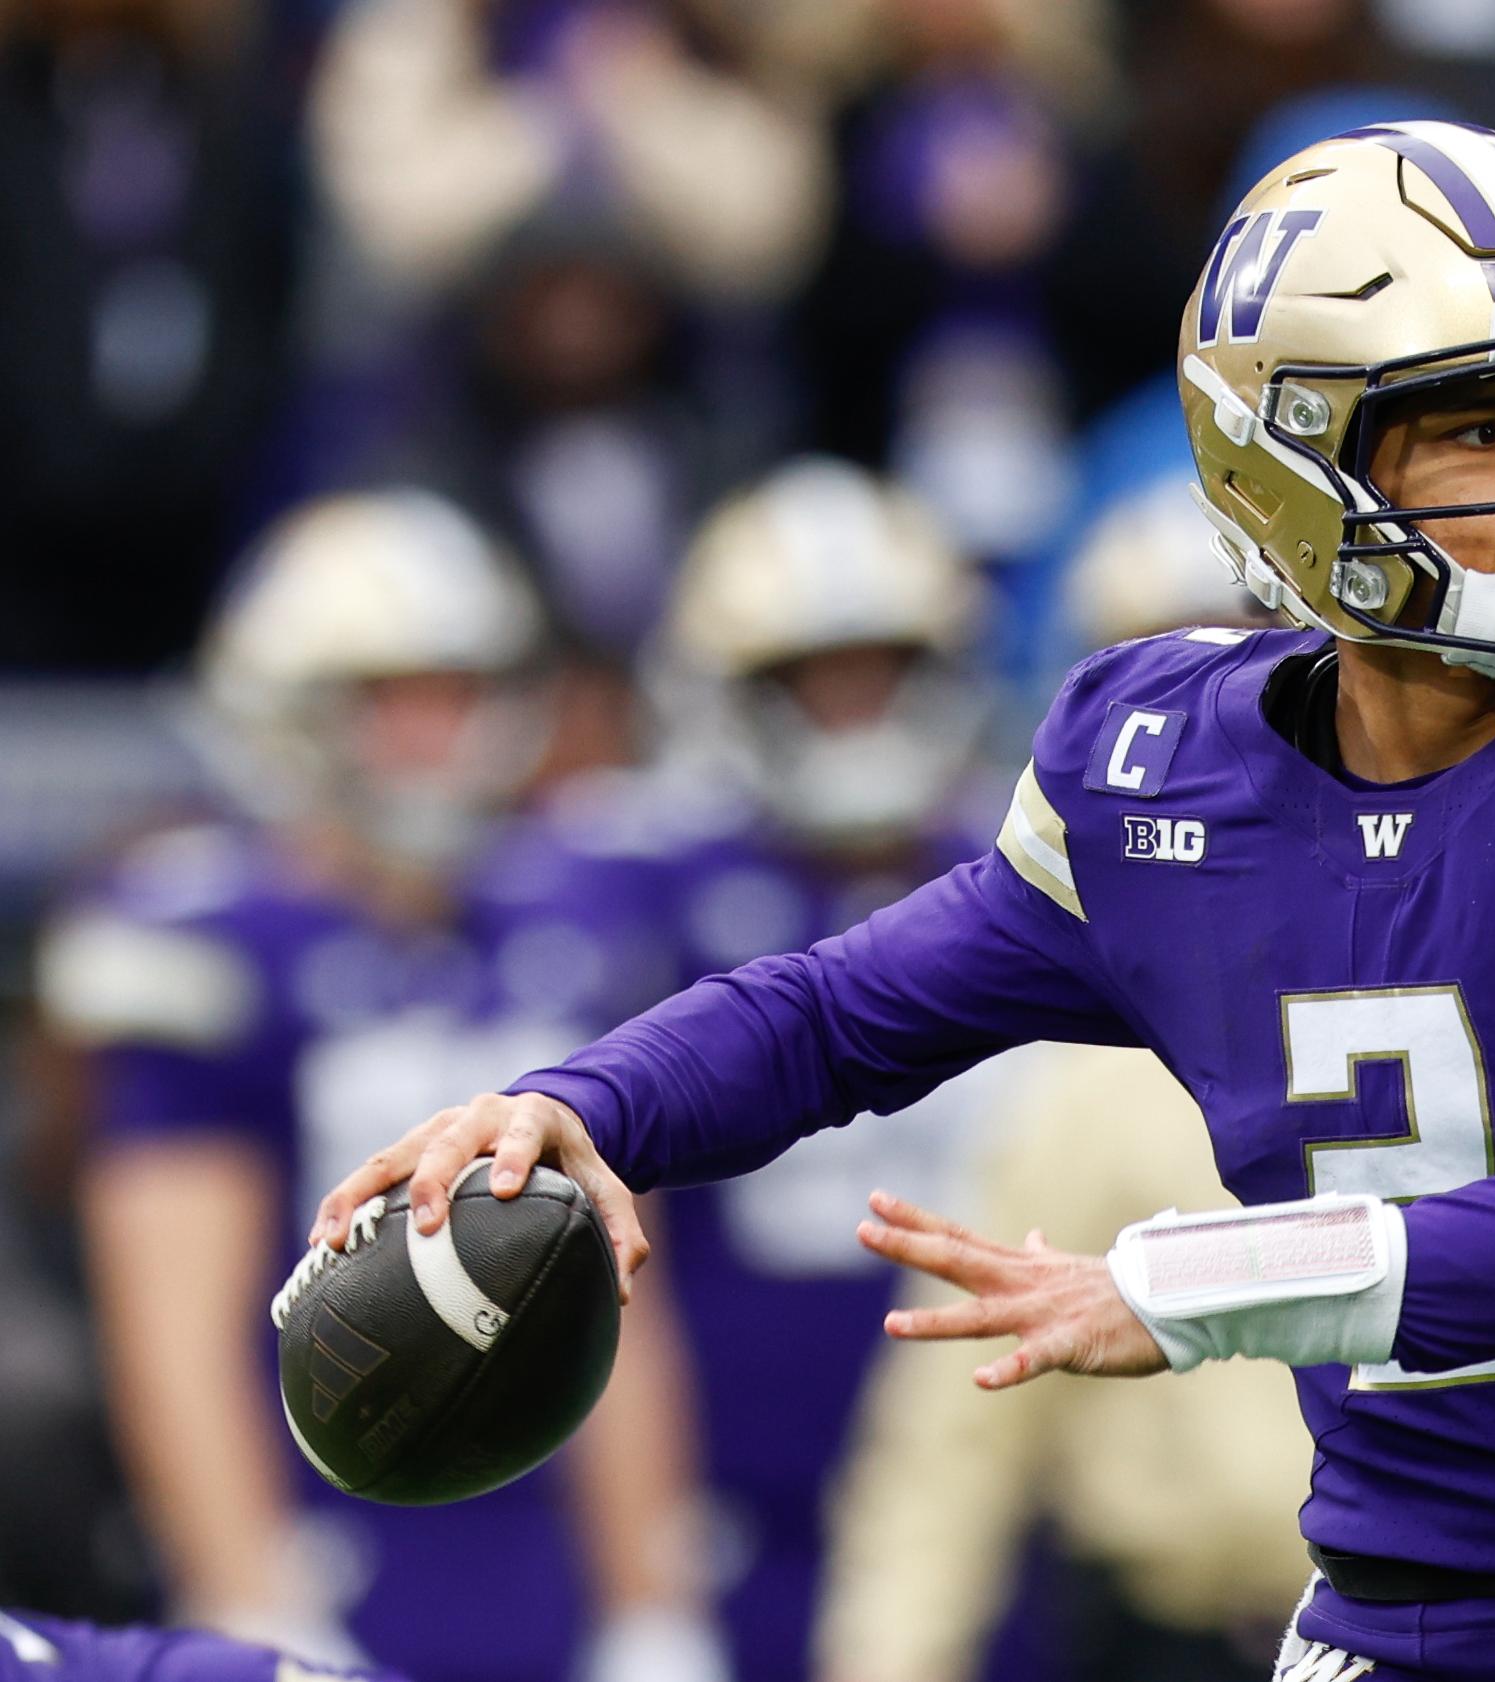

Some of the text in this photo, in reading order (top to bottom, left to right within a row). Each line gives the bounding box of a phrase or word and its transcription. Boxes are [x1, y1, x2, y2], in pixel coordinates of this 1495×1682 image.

[1197, 209, 1327, 349] W
[1106, 710, 1167, 790] C
[1356, 813, 1412, 858] W
